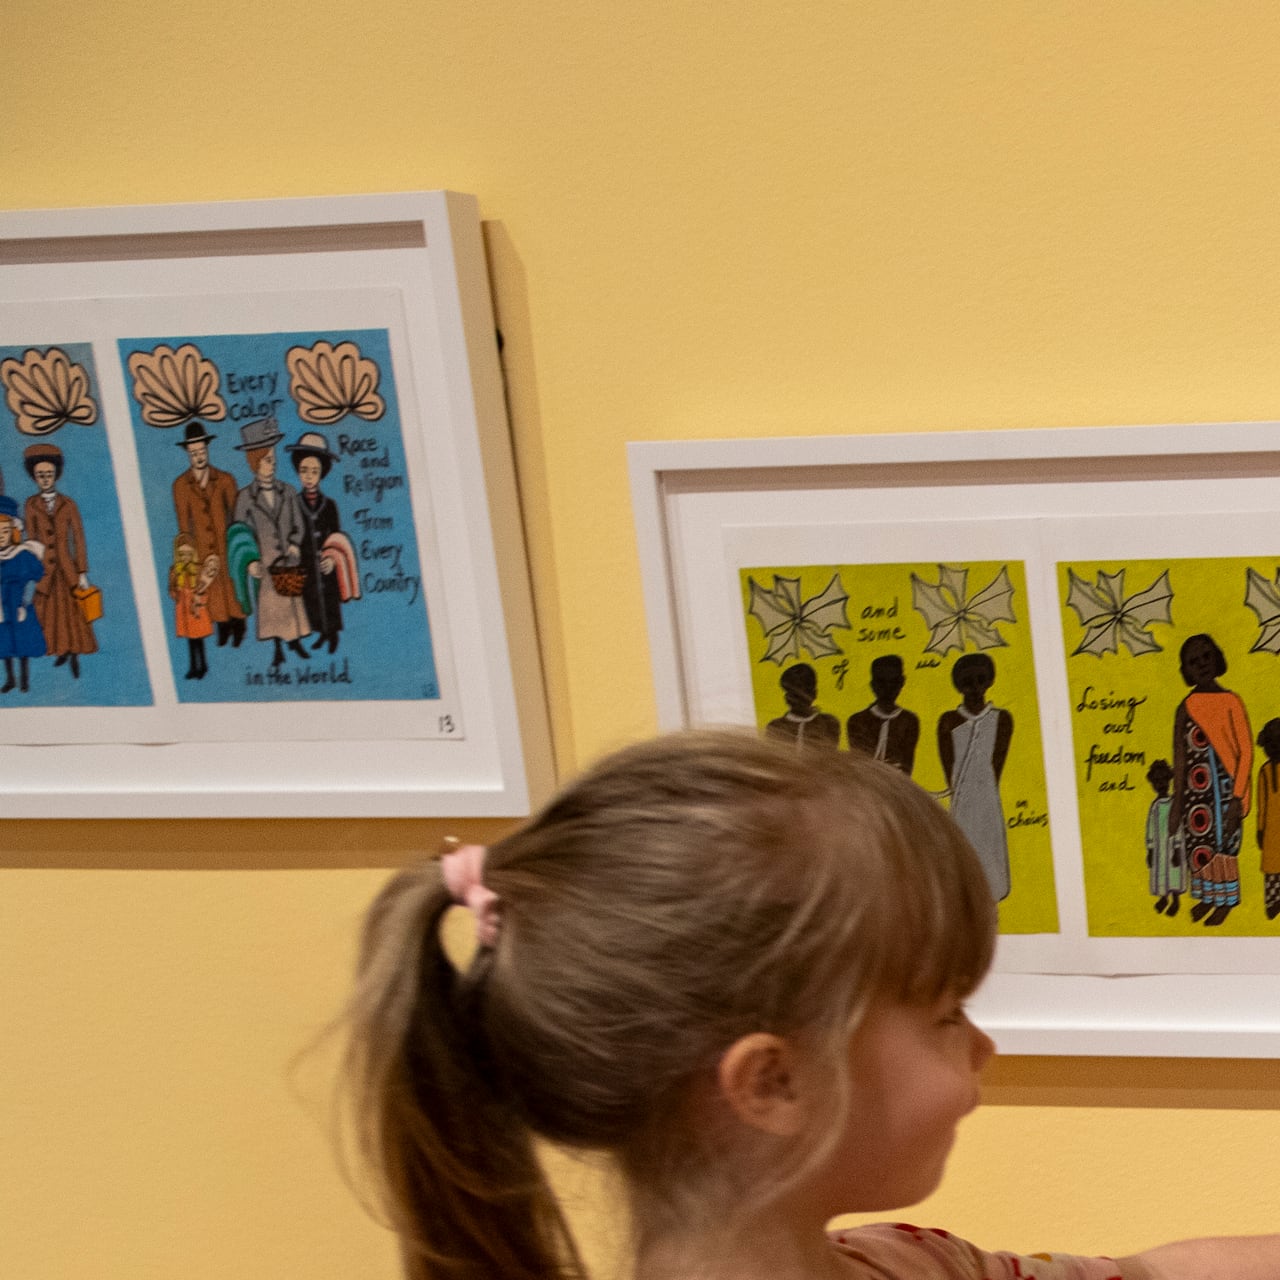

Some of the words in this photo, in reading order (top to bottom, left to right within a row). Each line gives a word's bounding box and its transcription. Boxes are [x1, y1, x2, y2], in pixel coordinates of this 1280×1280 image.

[226, 371, 279, 396] Every
[338, 435, 378, 455] Race
[360, 446, 390, 468] and
[361, 539, 403, 569] Every
[862, 596, 898, 620] and
[831, 658, 850, 691] of
[438, 714, 455, 733] 13
[1103, 722, 1133, 734] our
[1085, 744, 1146, 782] freedom
[1098, 773, 1136, 792] and
